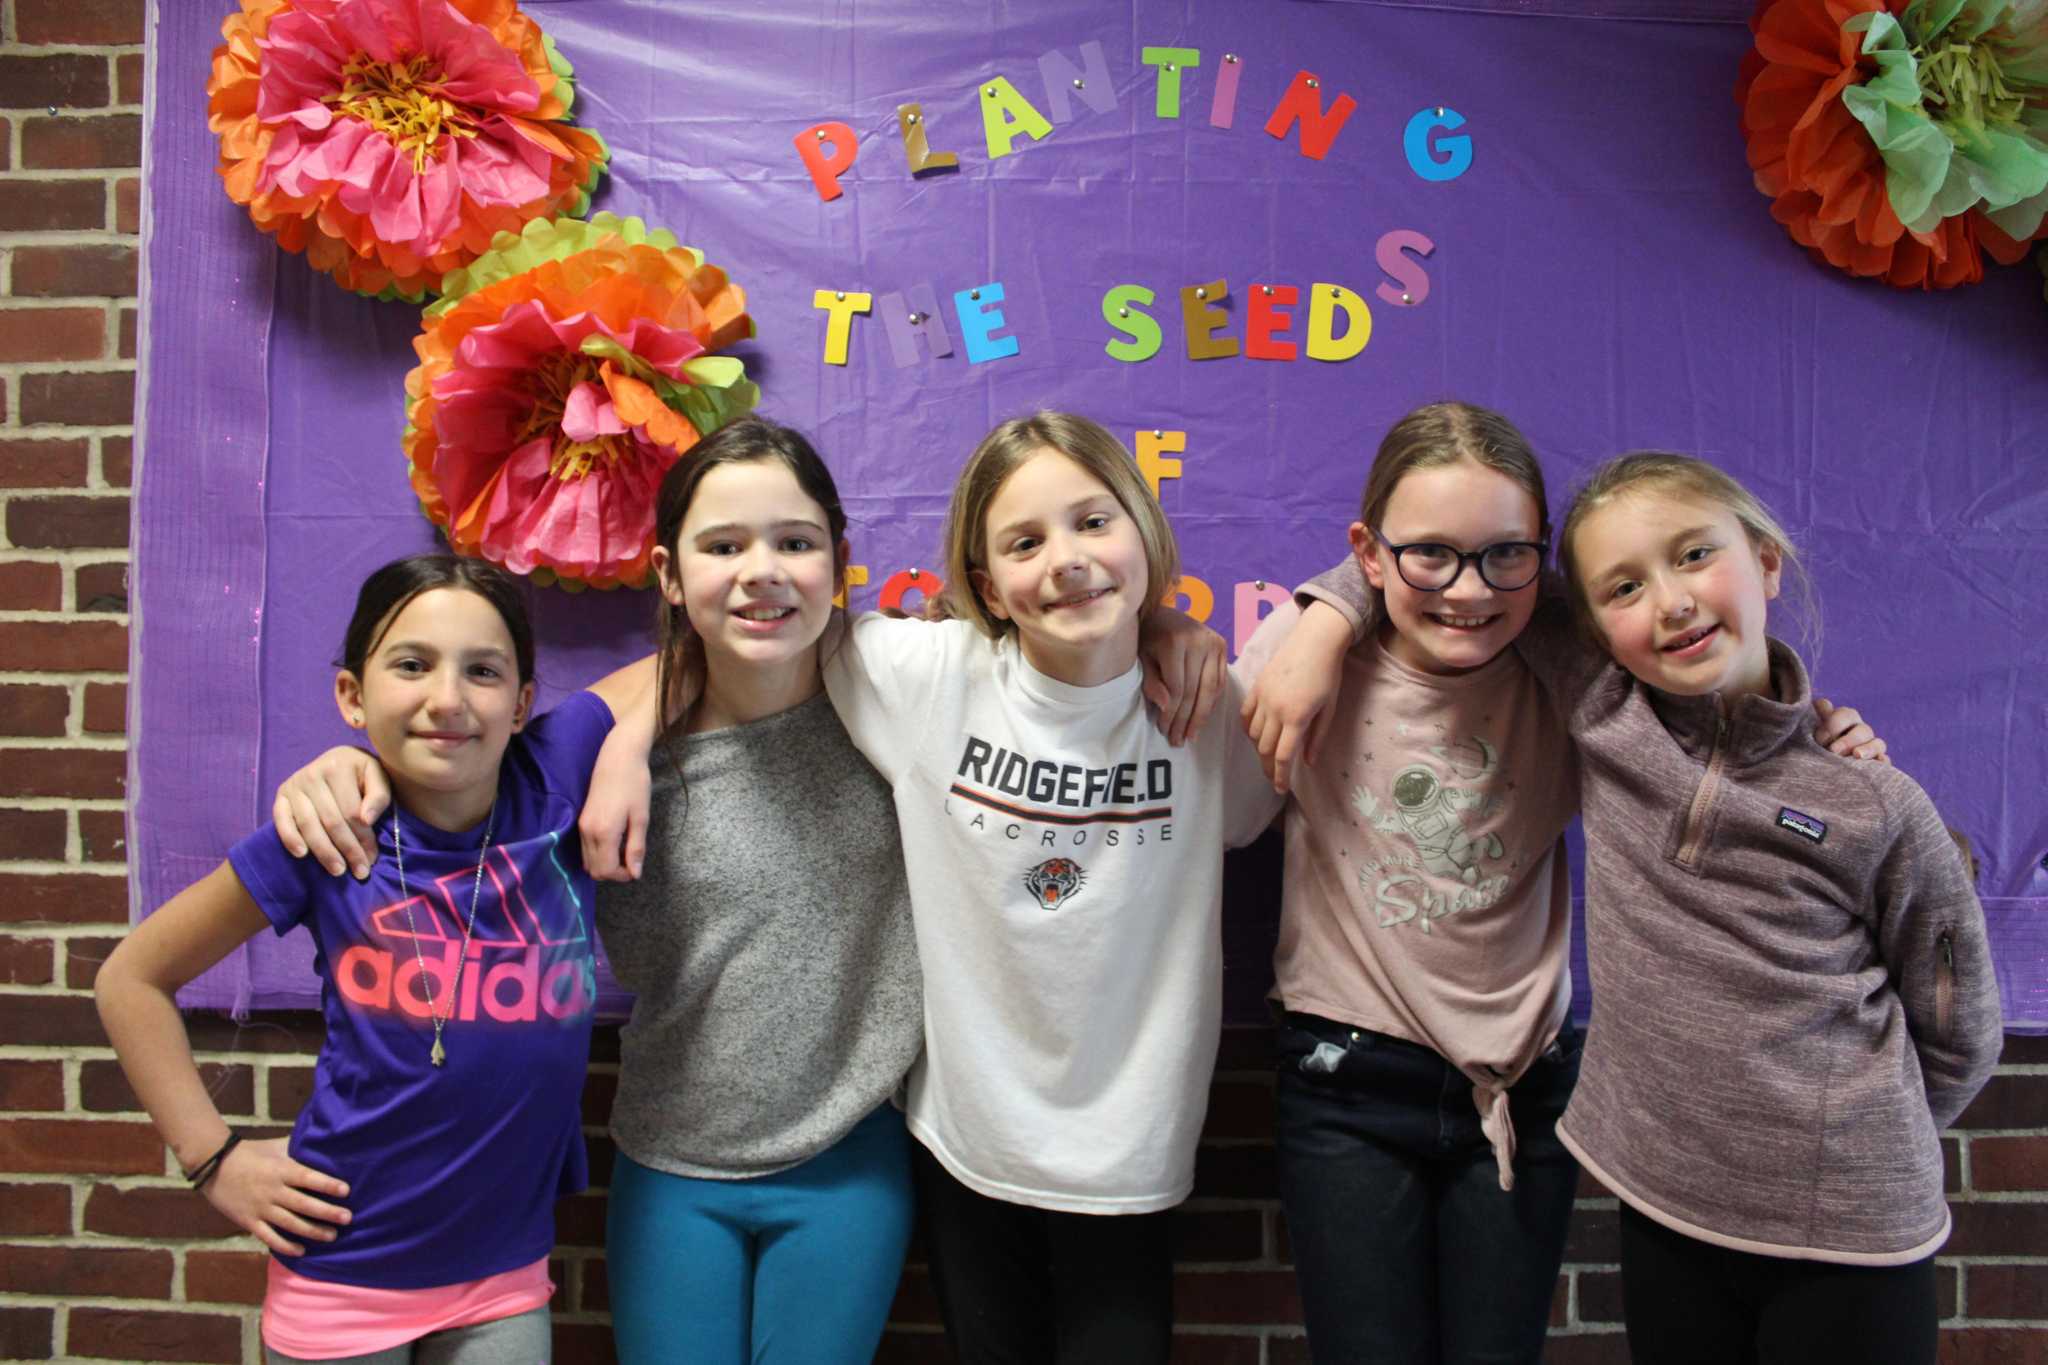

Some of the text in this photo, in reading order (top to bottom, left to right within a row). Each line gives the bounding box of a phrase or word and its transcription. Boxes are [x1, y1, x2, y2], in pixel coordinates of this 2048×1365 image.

[793, 40, 1473, 202] PLANTING
[813, 228, 1436, 367] THE SEEDS
[957, 736, 1172, 808] RIDGEFIED
